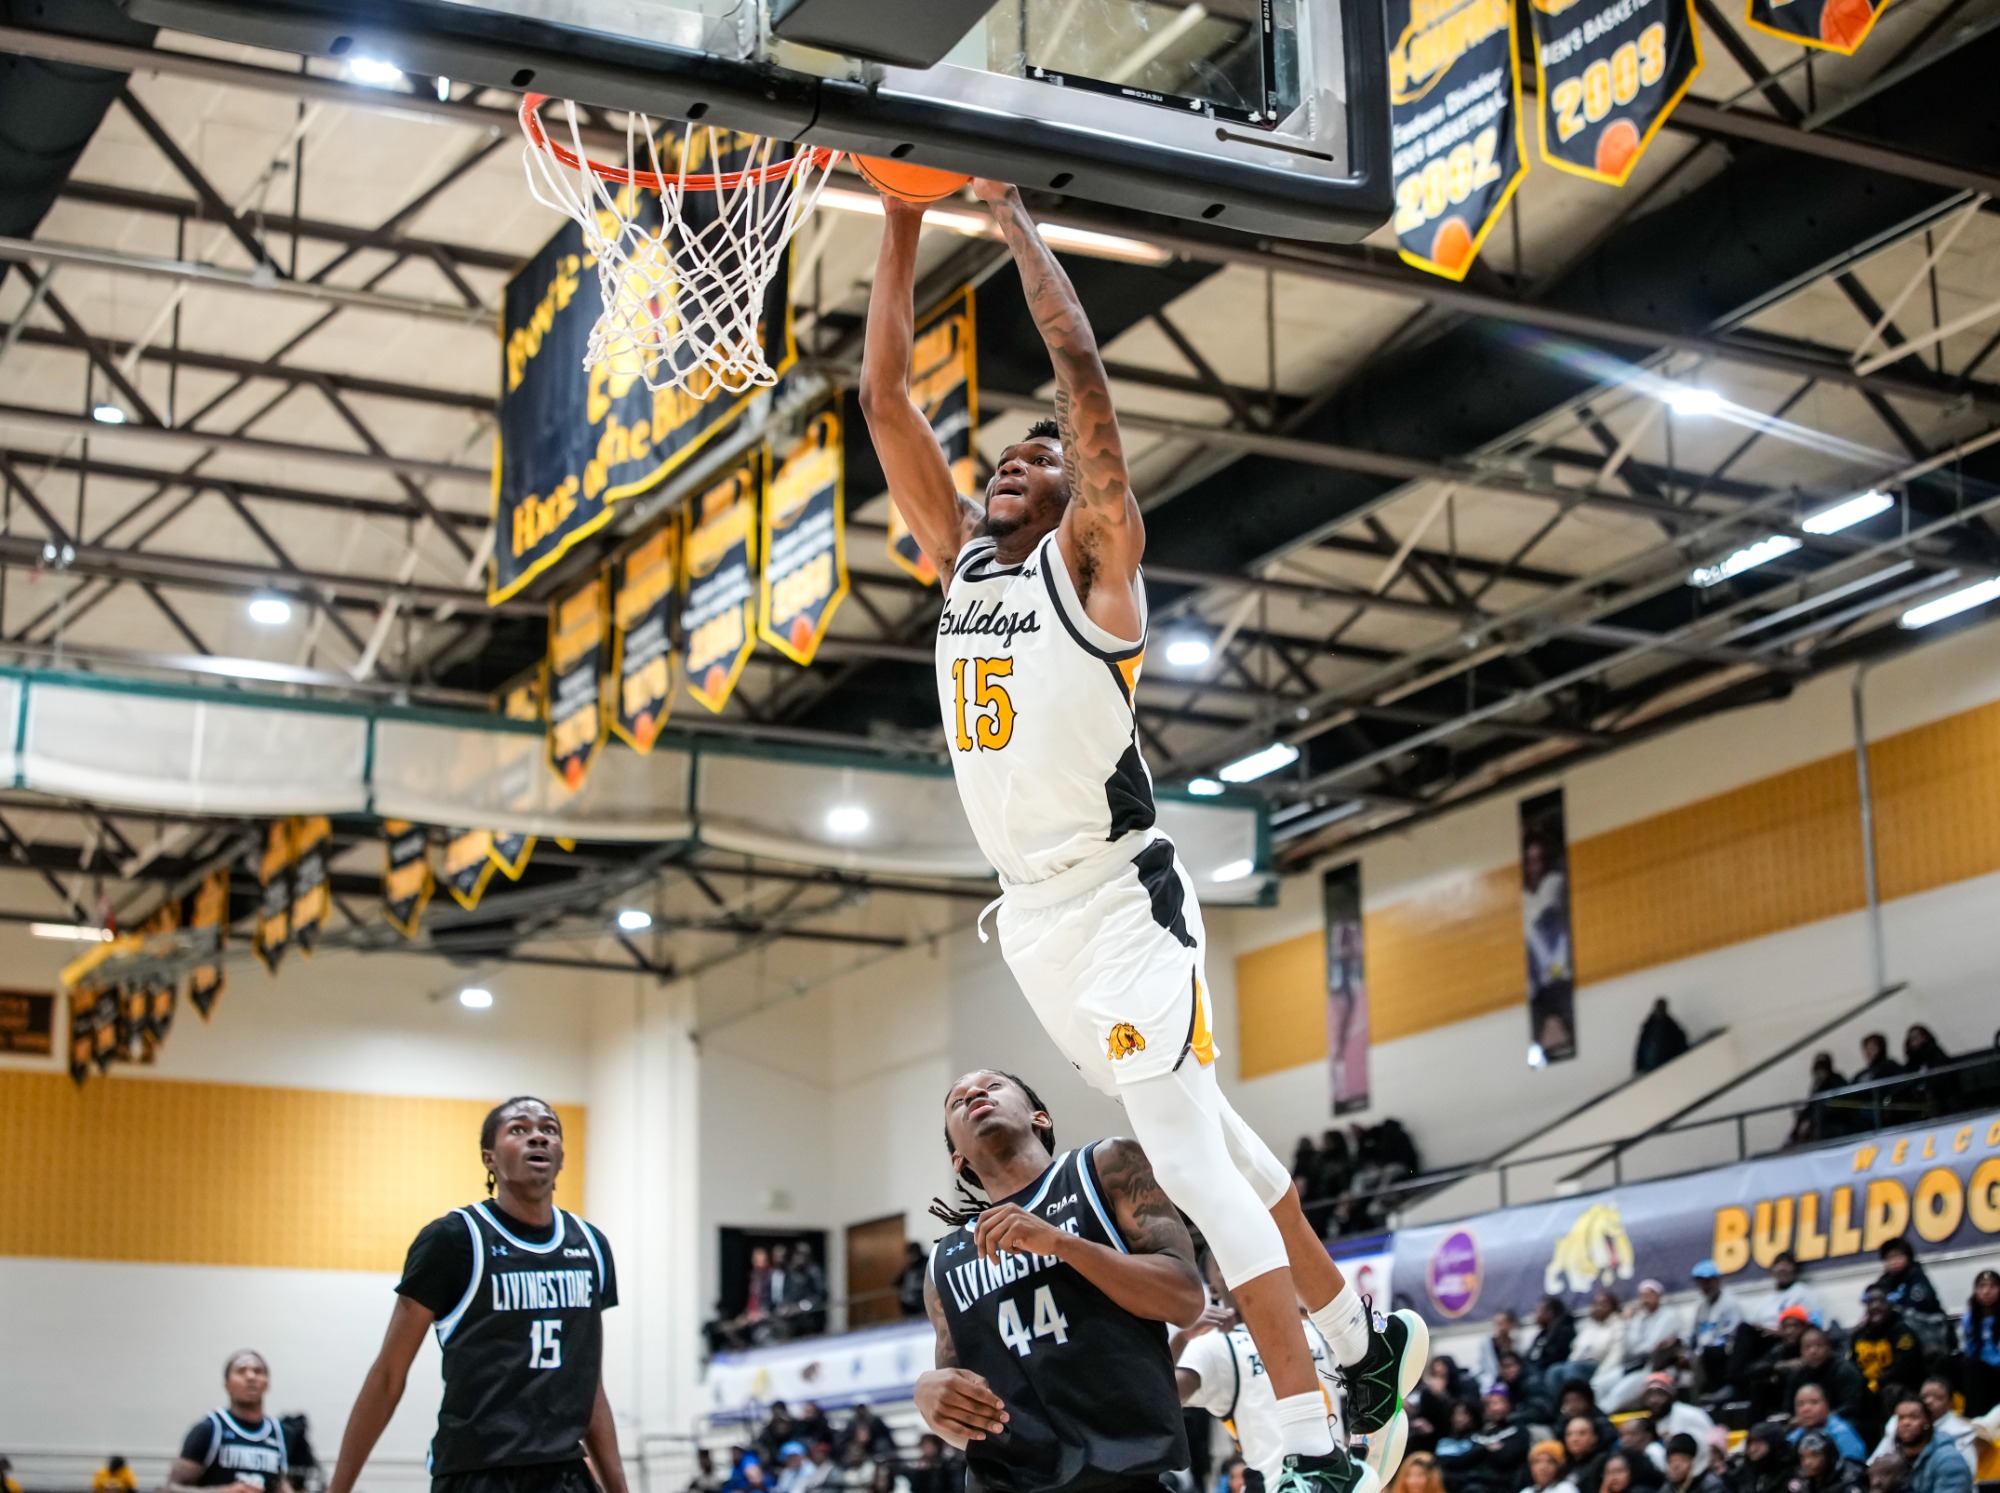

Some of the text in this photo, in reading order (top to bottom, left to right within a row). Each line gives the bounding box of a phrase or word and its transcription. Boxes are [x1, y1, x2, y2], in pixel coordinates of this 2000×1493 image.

[1551, 21, 1666, 143] 2003
[1394, 126, 1502, 235] 2002
[952, 655, 1018, 753] 15
[1046, 1193, 1078, 1217] CIAA
[491, 1269, 593, 1311] LIVINGSTONE
[998, 1284, 1069, 1358] 44
[528, 1319, 563, 1369] 15
